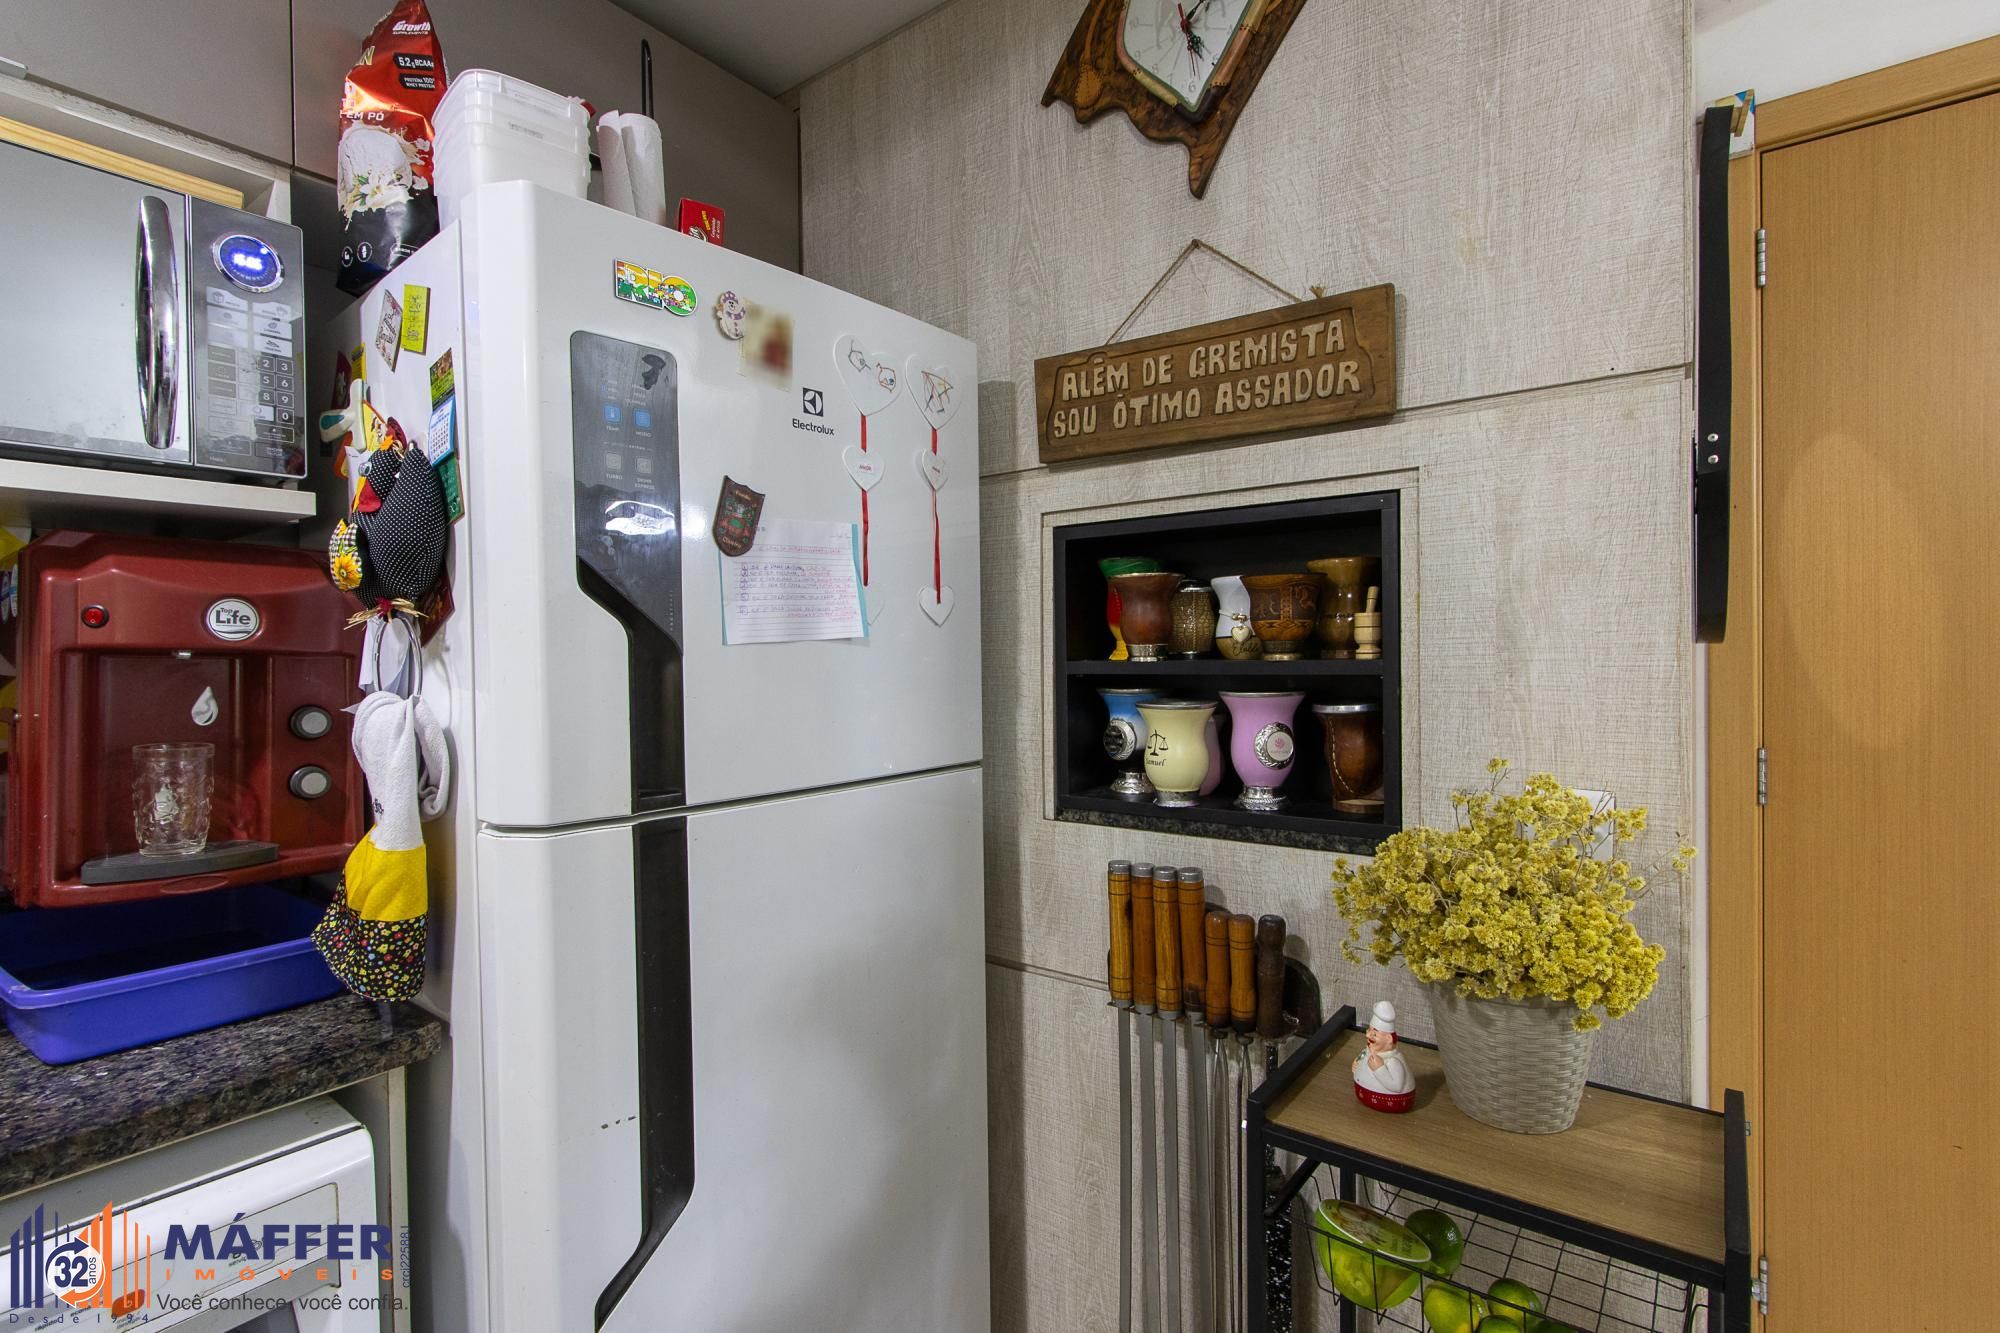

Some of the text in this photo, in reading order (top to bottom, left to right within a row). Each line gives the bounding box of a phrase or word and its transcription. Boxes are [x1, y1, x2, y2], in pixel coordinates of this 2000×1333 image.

[392, 20, 431, 31] Growth
[1188, 82, 1196, 93] 6
[368, 110, 384, 121] PÓ
[615, 259, 698, 316] RIO
[1142, 354, 1173, 386] DE
[1188, 319, 1346, 379] GREMISTA
[262, 360, 270, 368] 2
[281, 363, 288, 371] 3
[263, 376, 270, 384] 5
[263, 392, 270, 401] 8
[282, 396, 289, 404] 9
[1054, 404, 1098, 438] SOU
[1215, 360, 1362, 415] ASSADOR
[282, 412, 289, 420] 0
[792, 418, 834, 436] Electrolux
[216, 610, 251, 625] Life
